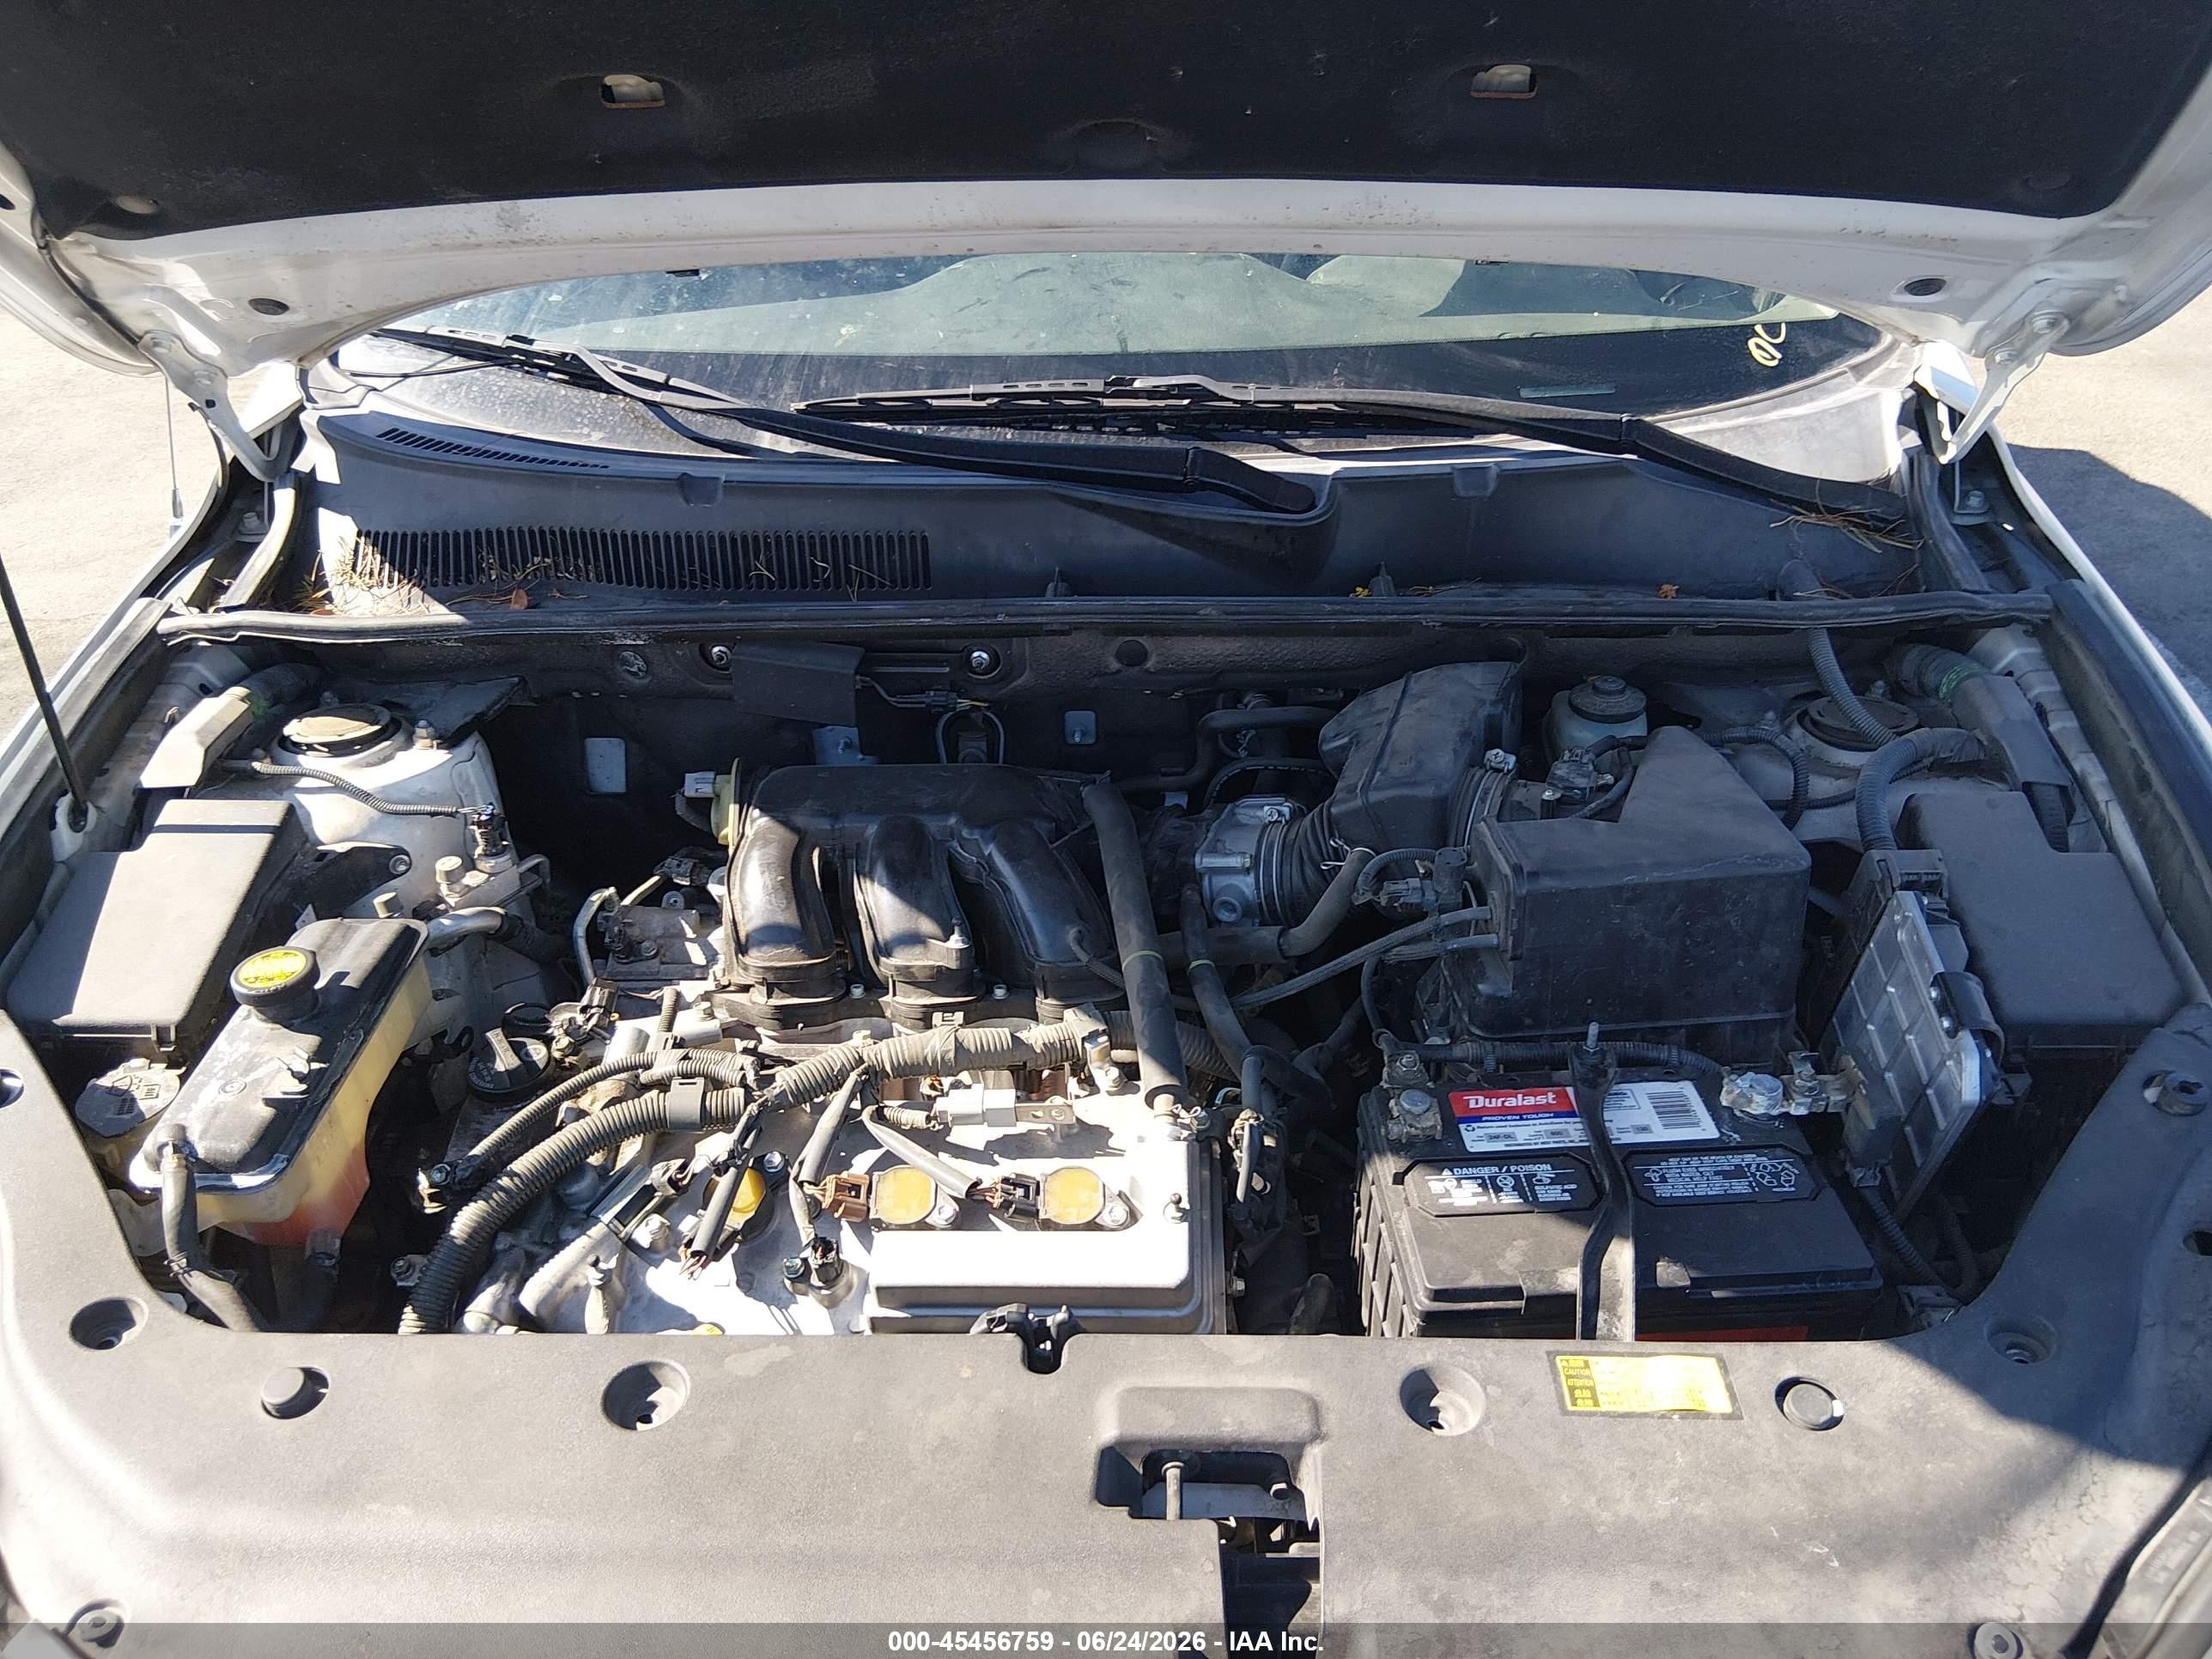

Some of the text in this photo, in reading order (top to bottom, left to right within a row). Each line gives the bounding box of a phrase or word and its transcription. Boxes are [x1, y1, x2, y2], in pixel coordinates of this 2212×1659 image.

[1462, 1091, 1558, 1109] Duralast
[1453, 1165, 1499, 1176] DANGER
[1510, 1164, 1553, 1172] POISON
